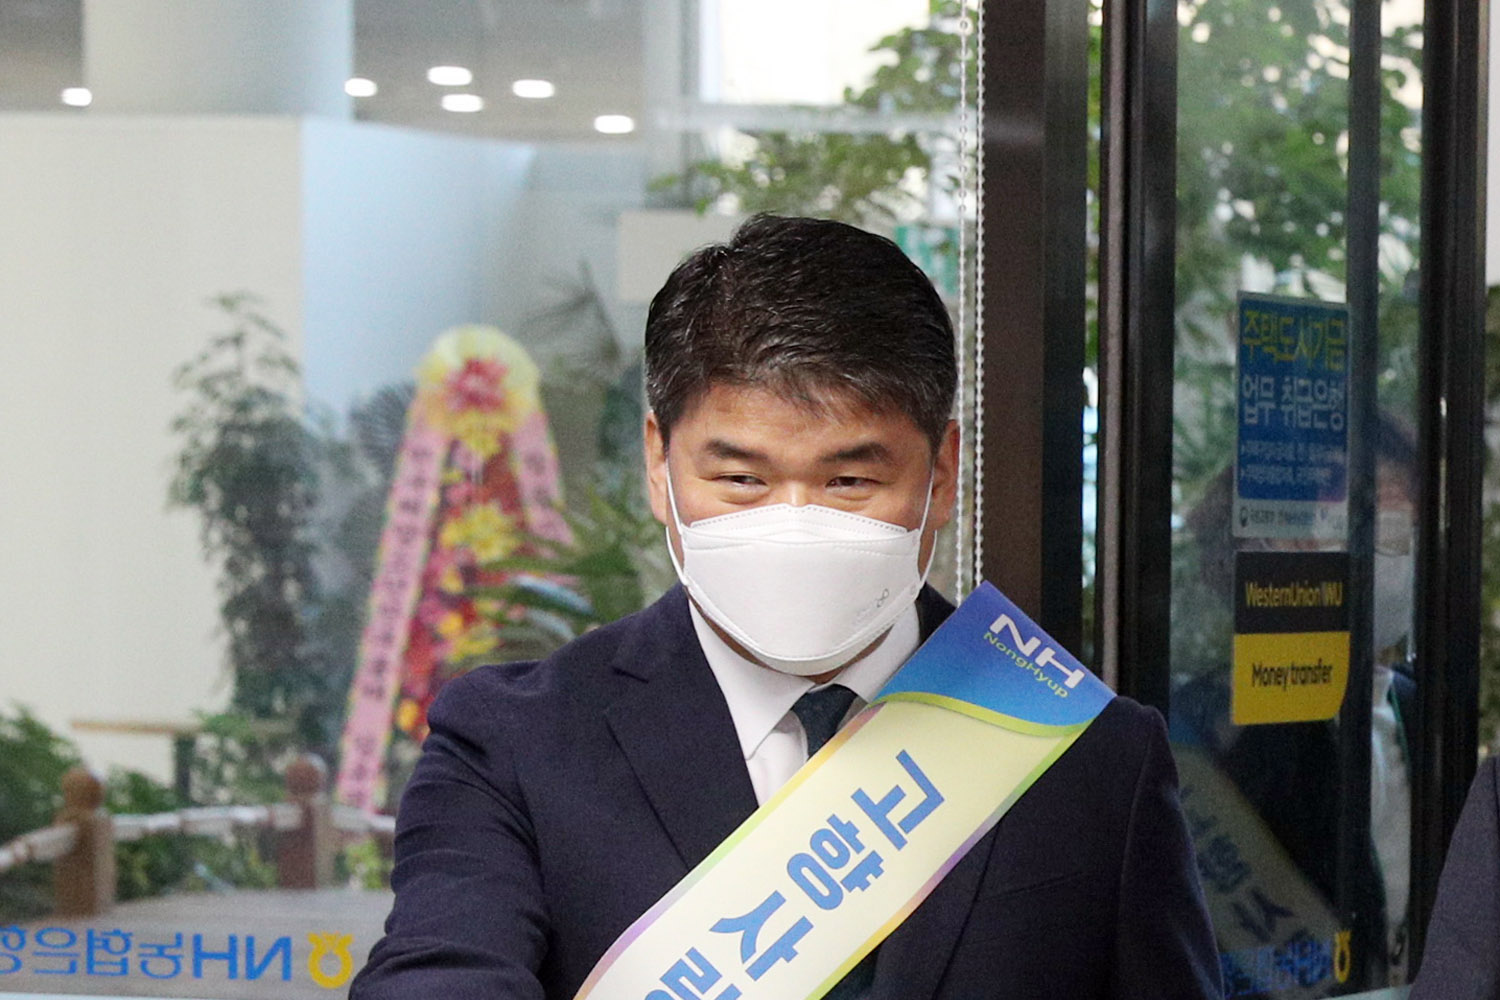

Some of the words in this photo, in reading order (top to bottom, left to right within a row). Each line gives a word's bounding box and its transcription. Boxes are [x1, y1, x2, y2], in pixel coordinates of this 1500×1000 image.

[1243, 310, 1345, 371] 주택도시기금
[1242, 374, 1276, 426] 업무
[1281, 376, 1344, 431] 취급은행
[1246, 580, 1320, 608] WesternUnion
[983, 631, 1069, 698] NongHyup
[989, 613, 1085, 689] NH
[1252, 661, 1288, 691] Money
[1290, 658, 1333, 686] transfer
